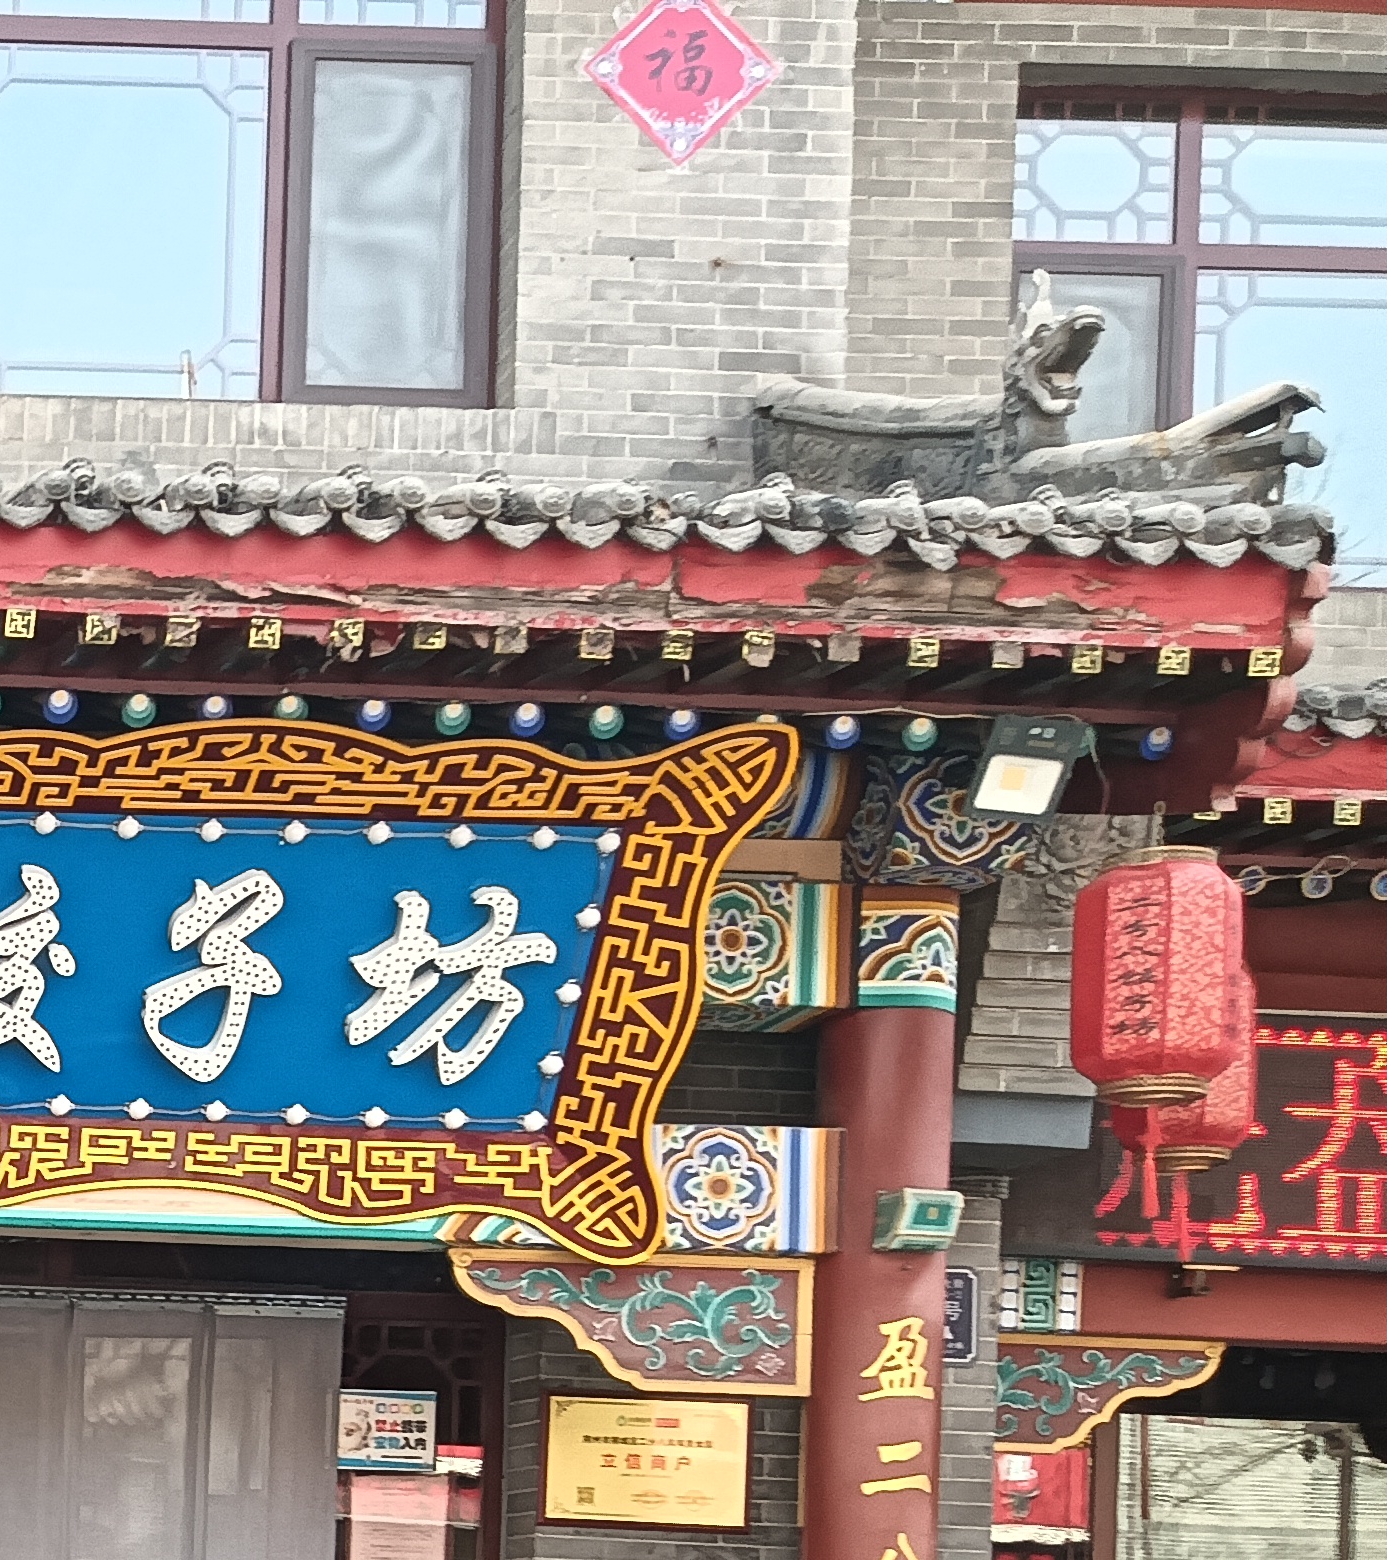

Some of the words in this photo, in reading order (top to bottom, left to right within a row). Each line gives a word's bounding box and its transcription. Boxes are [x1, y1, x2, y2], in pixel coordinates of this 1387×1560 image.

[645, 29, 714, 96] 福
[599, 1453, 691, 1470] 立信商户
